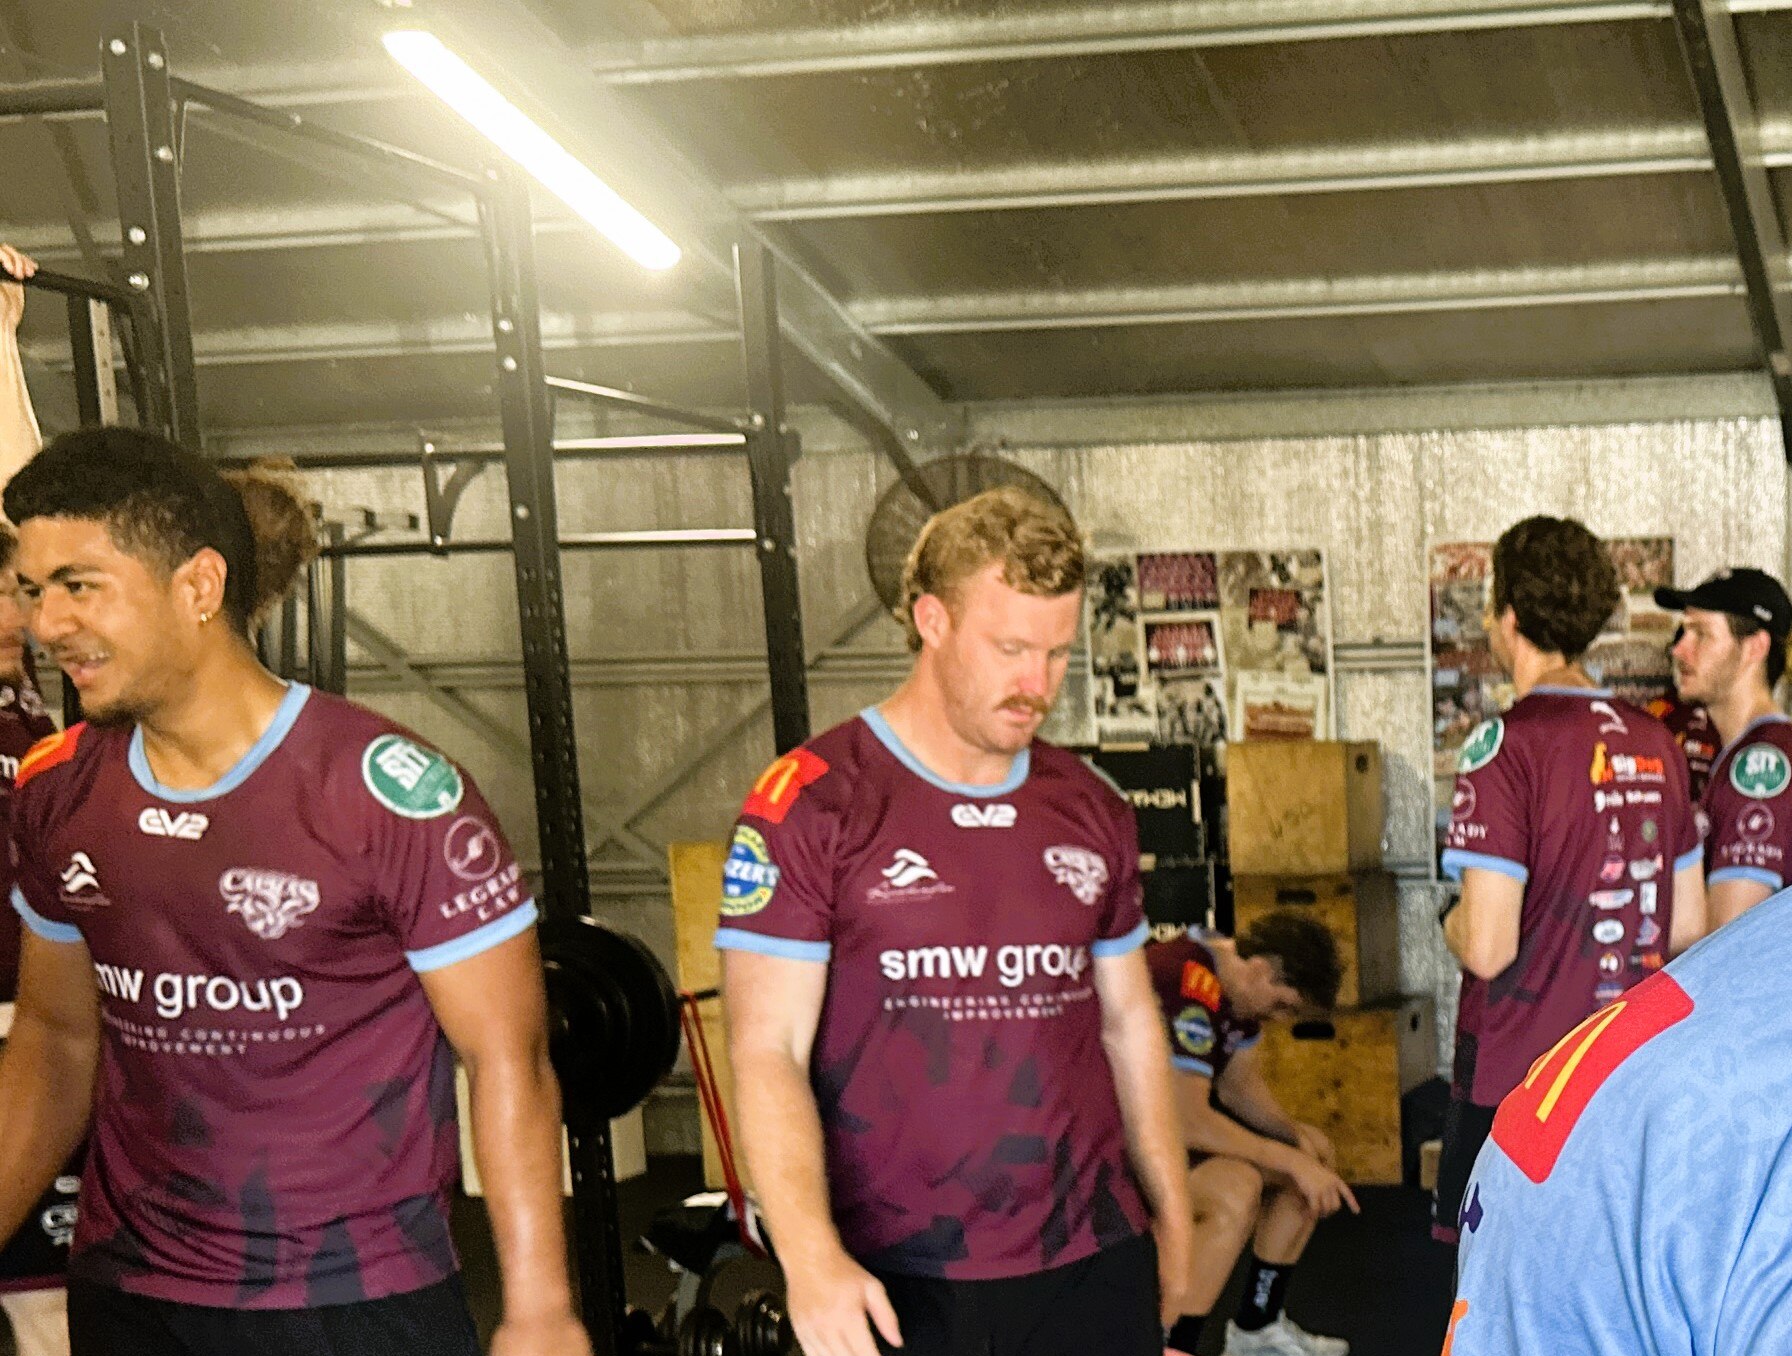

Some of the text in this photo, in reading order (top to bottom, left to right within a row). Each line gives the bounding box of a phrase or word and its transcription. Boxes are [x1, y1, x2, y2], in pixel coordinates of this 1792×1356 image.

[880, 945, 988, 981] smw
[95, 962, 304, 1021] mw group
